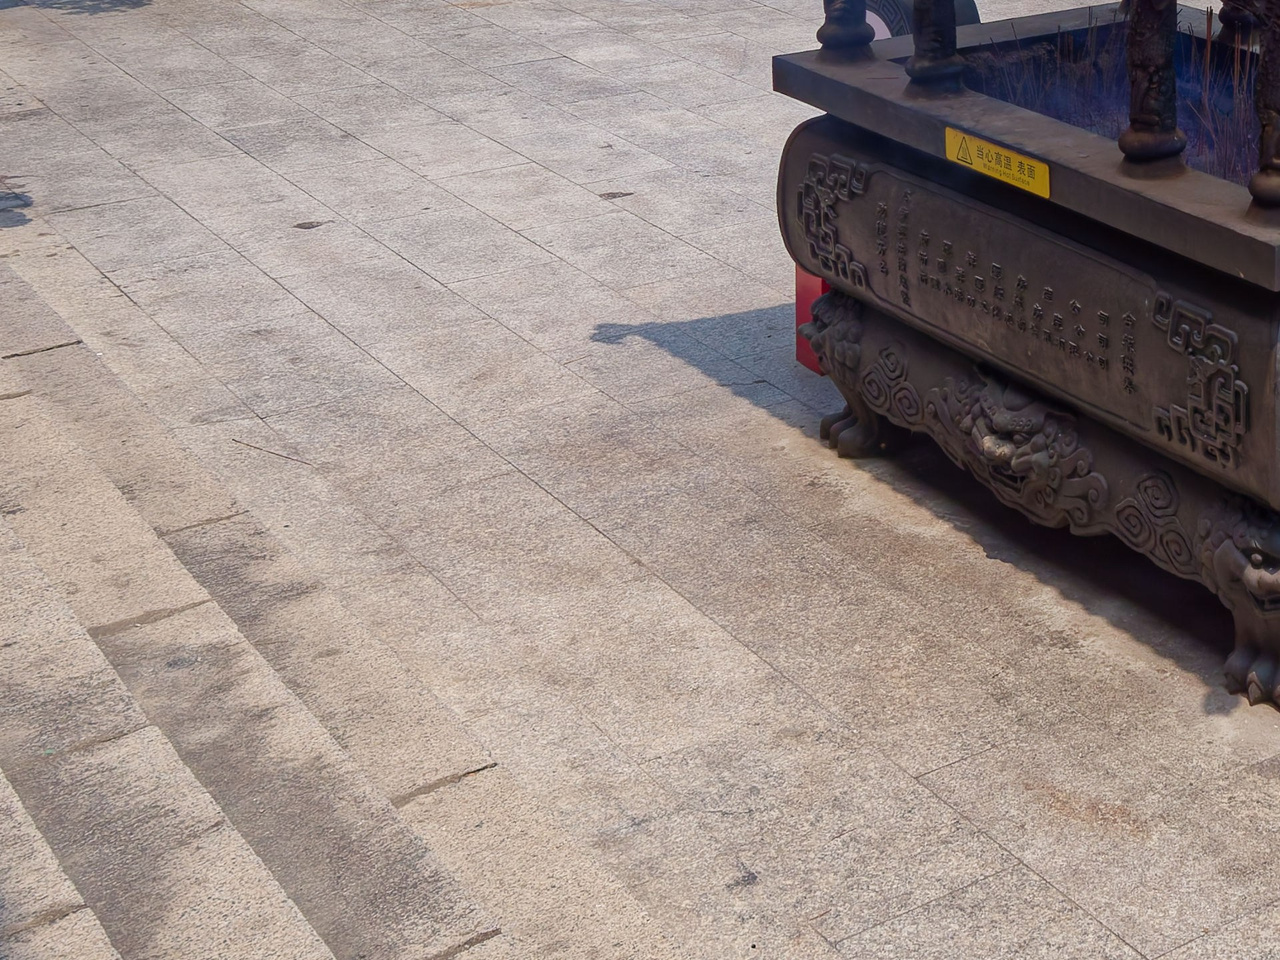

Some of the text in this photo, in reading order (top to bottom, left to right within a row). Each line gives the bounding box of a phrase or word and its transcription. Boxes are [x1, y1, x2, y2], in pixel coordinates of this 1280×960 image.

[976, 144, 1036, 180] 当心高温 表面
